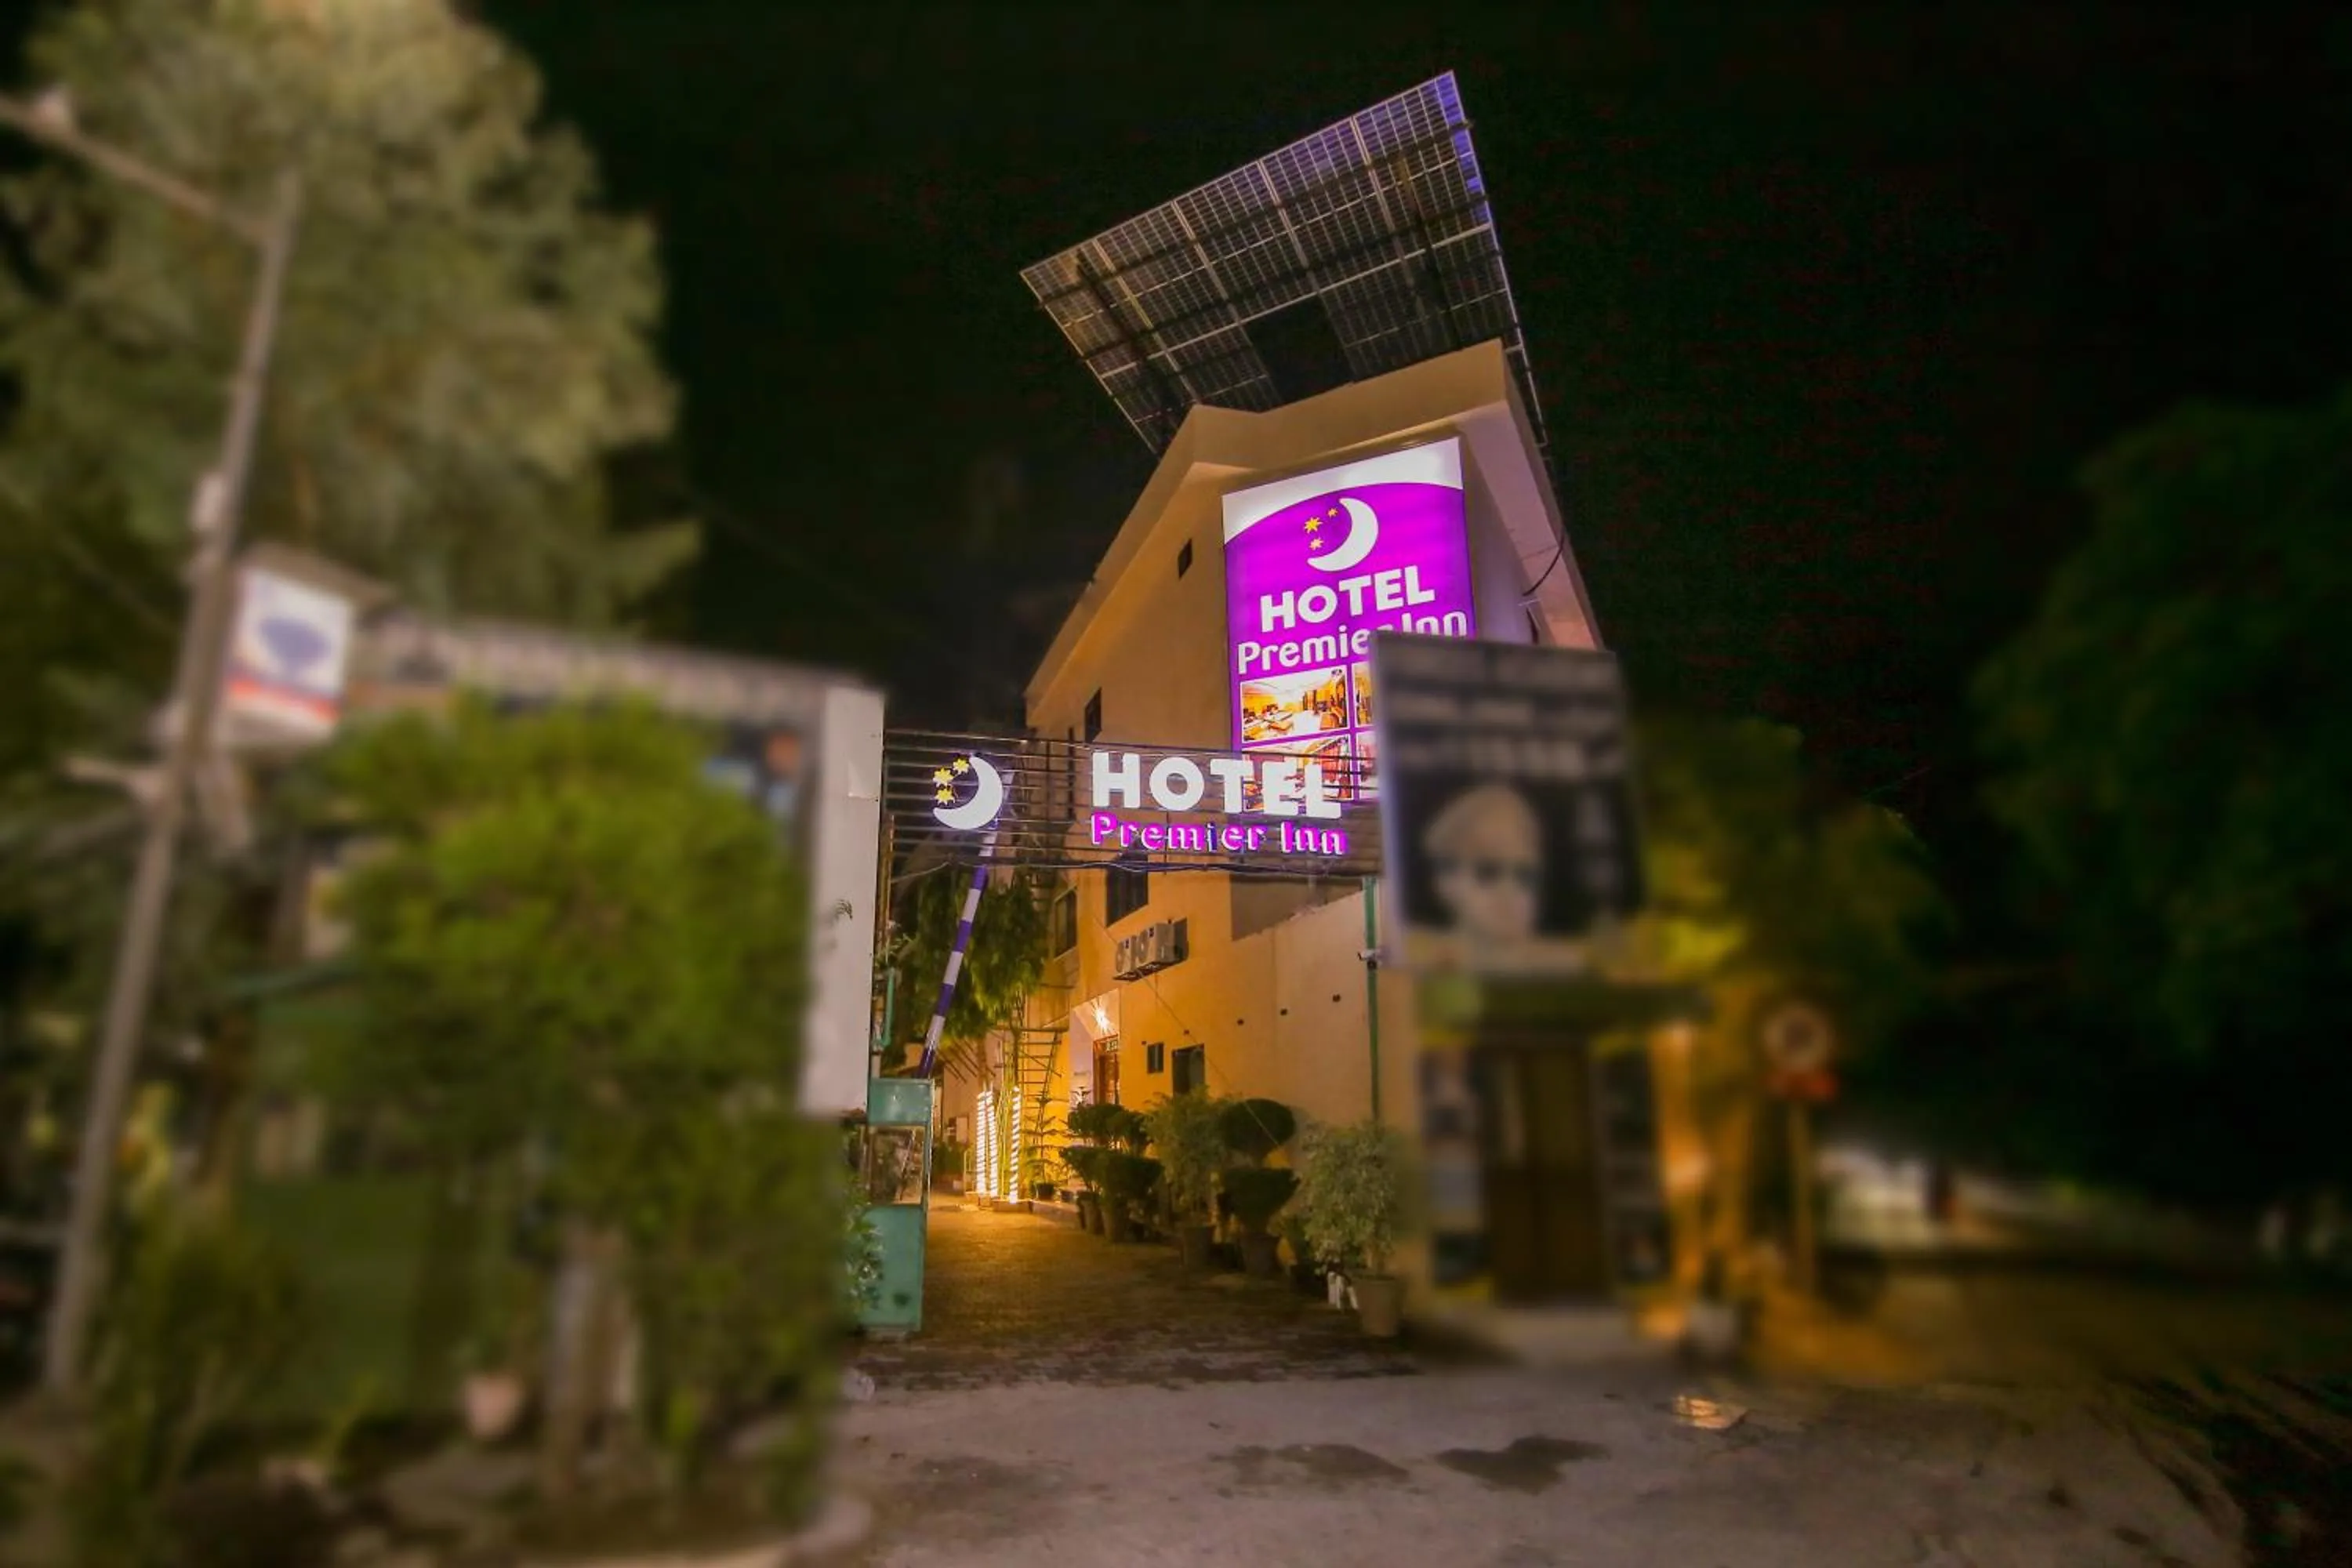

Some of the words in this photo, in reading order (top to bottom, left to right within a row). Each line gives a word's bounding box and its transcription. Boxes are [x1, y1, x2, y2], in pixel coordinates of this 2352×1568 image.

[1260, 564, 1436, 633] HOTEL
[1237, 624, 1393, 674] Premie
[1092, 751, 1341, 818] HOTEL
[1091, 812, 1267, 852] Premier
[1280, 821, 1348, 855] Inn
